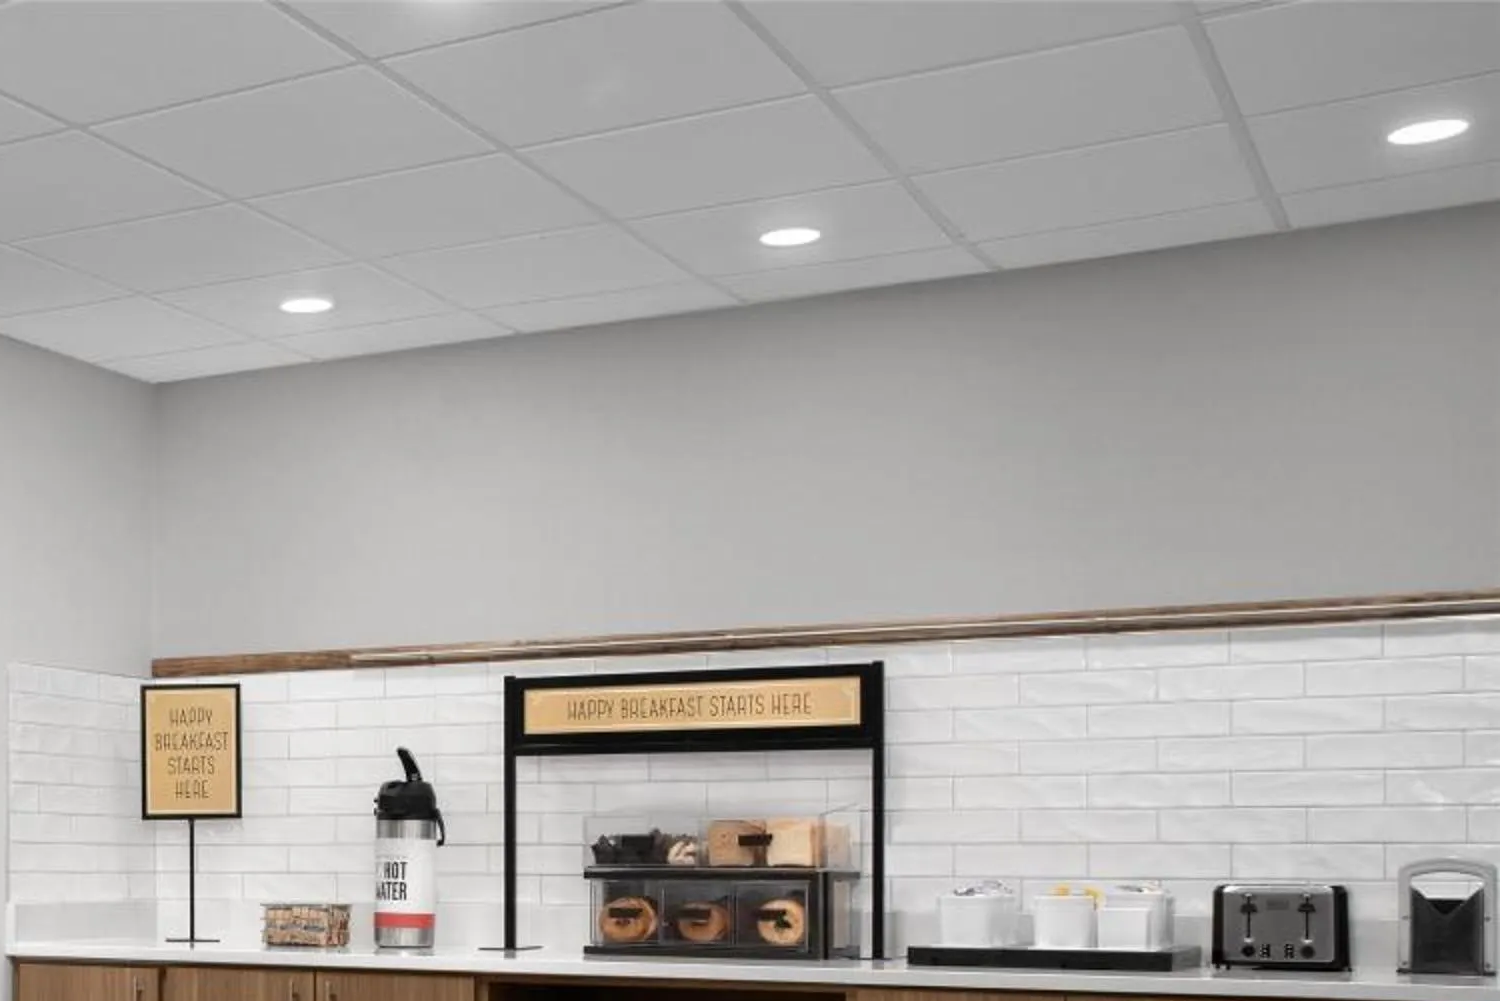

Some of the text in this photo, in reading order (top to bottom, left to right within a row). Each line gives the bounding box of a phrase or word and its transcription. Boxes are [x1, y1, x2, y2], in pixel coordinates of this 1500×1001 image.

[566, 692, 811, 721] HAPPY BREAKFAST STARTS HERE
[169, 707, 213, 726] HAPPY
[154, 731, 228, 751] BREAKFAST
[167, 756, 214, 775] STARTS
[175, 780, 209, 799] HERE
[384, 861, 408, 880] HOT
